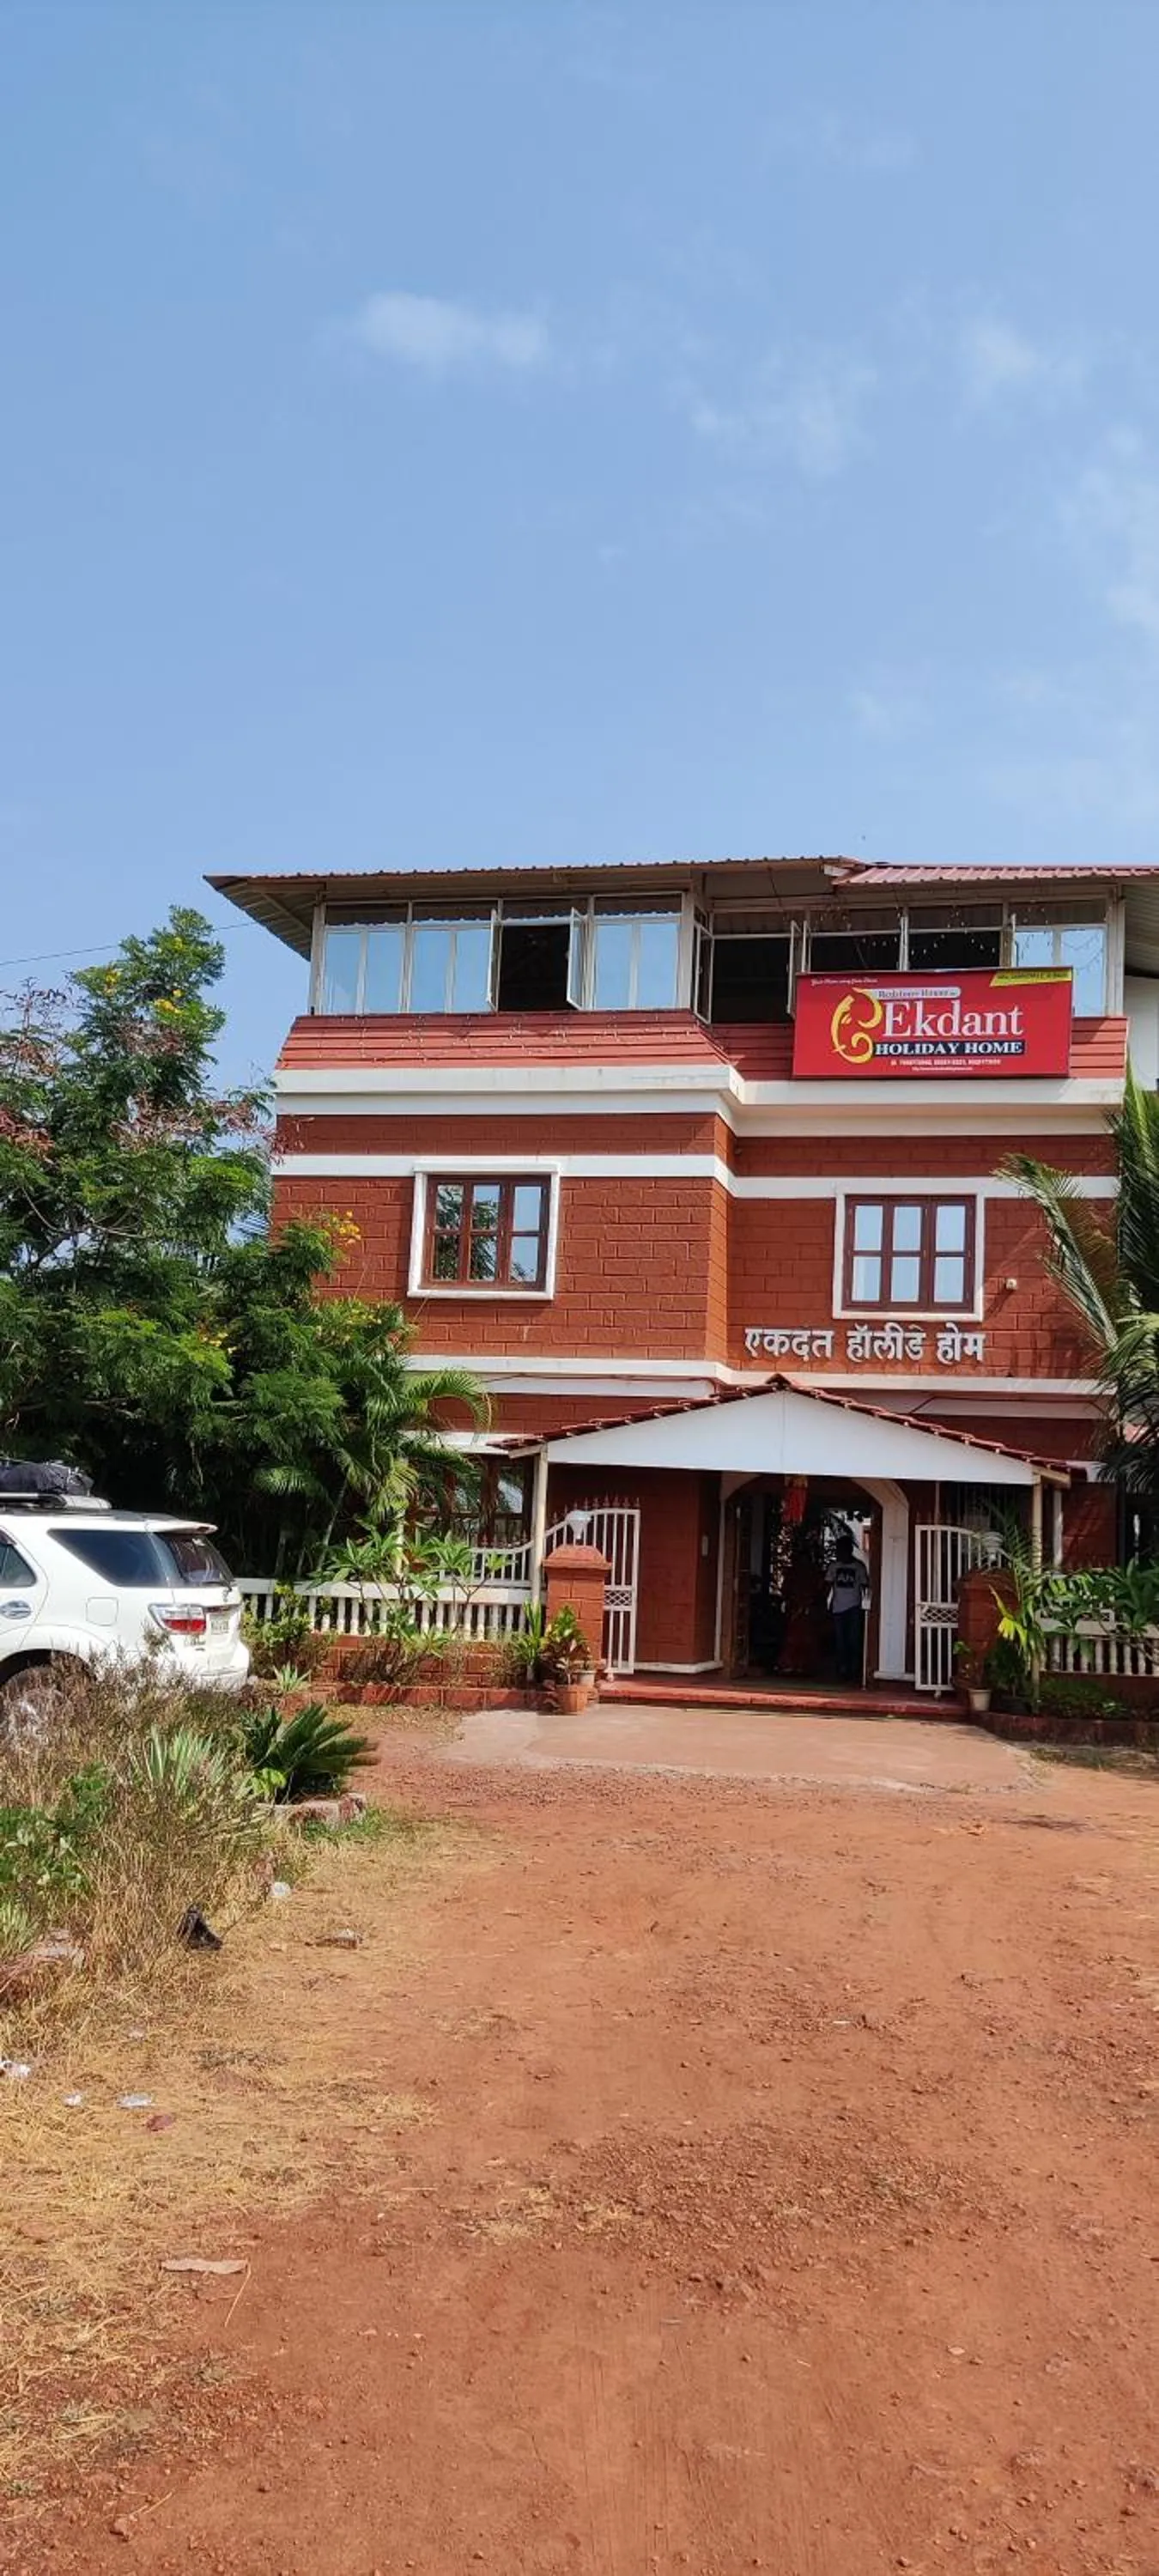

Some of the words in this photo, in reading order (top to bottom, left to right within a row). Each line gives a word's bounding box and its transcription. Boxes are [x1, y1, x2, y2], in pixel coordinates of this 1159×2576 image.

[883, 1000, 1023, 1036] Ekdant
[875, 1042, 959, 1055] HOLIDAY
[964, 1042, 1022, 1054] HOME
[846, 1321, 926, 1363] हॉलीडे
[936, 1322, 986, 1364] होम
